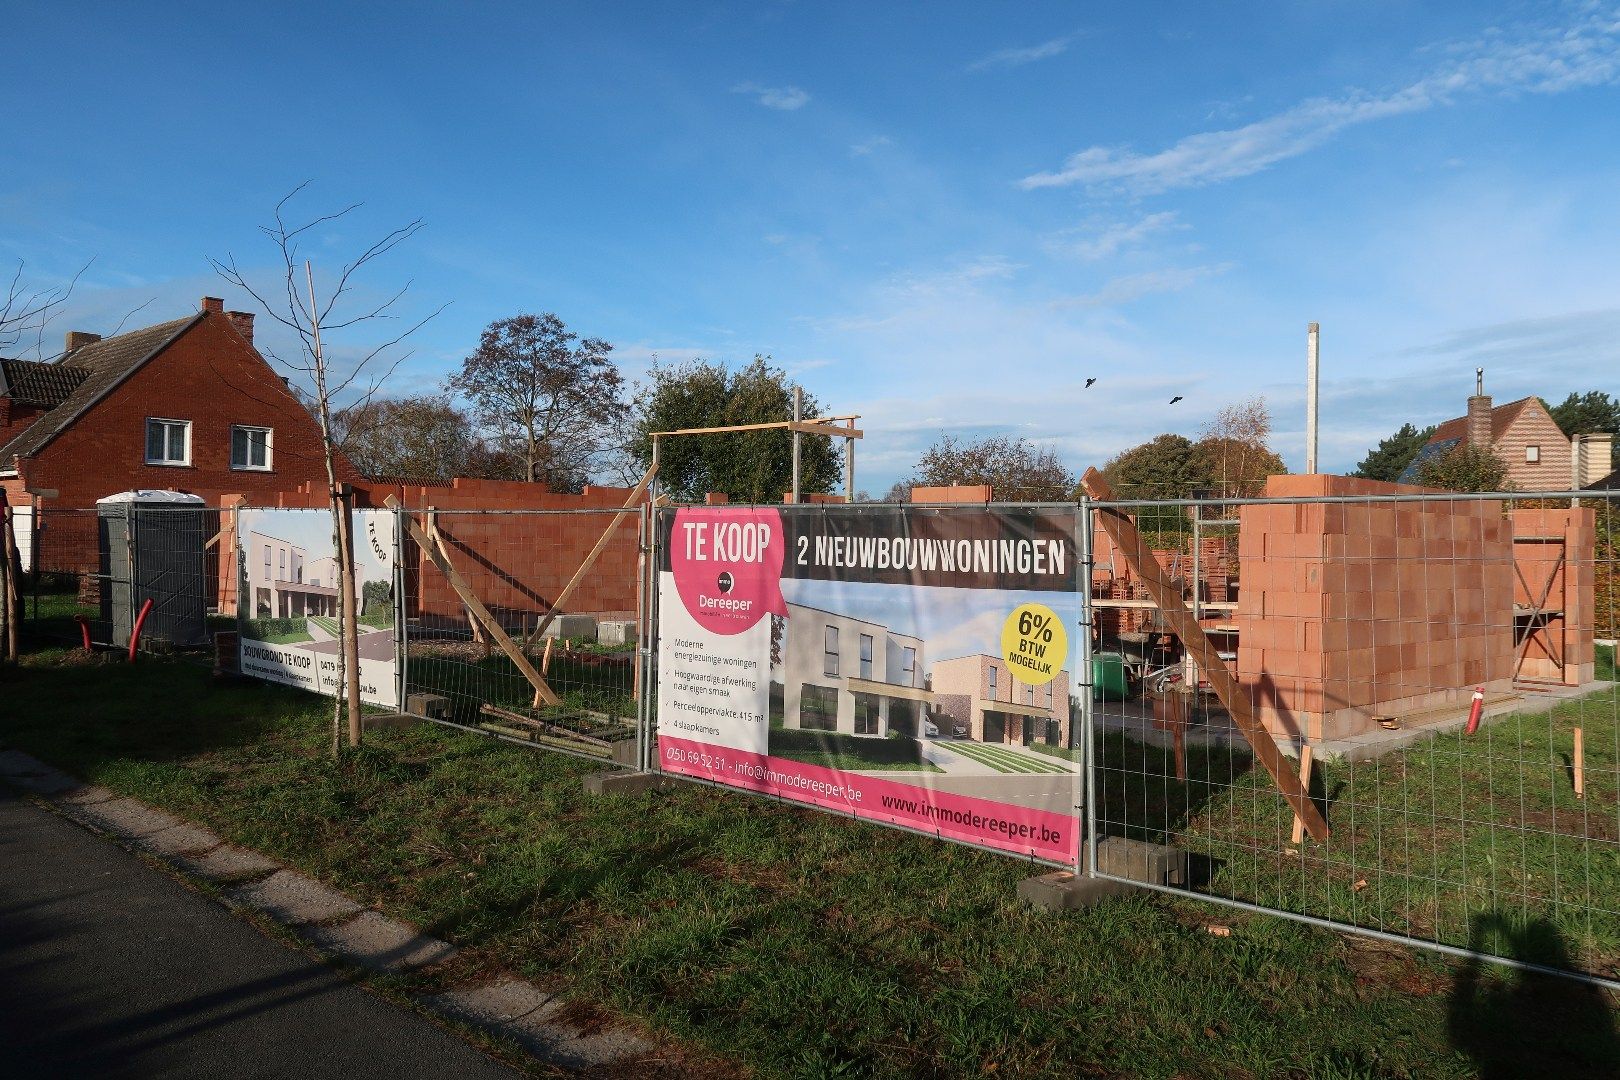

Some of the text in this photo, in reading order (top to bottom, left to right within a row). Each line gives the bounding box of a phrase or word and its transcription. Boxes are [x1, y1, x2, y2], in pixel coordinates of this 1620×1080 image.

[369, 521, 386, 562] TE KOOP
[683, 523, 770, 562] TE KOOP
[797, 536, 1065, 575] 2 NIEUWBOUWWONINGEN
[700, 594, 752, 612] Dereeper
[1018, 610, 1052, 642] 6%
[674, 638, 704, 650] Moderne
[1019, 638, 1046, 658] BTW
[244, 645, 310, 669] BOUWGROND TE KOOP
[320, 660, 335, 671] 0479
[674, 651, 756, 670] energiezuinige woningen
[1008, 652, 1052, 674] MOGELIJK
[674, 670, 756, 692] Hoogwaardige afwerking
[674, 682, 688, 690] naar
[690, 684, 708, 696] eigen
[740, 712, 752, 722] 415
[754, 714, 764, 722] m²
[679, 721, 720, 736] slaapkamers
[666, 747, 686, 761] 050
[688, 750, 698, 764] 69
[701, 754, 712, 768] 52
[735, 760, 862, 802] info@immodereeper.be
[882, 794, 1060, 844] www.immodereeper.be
